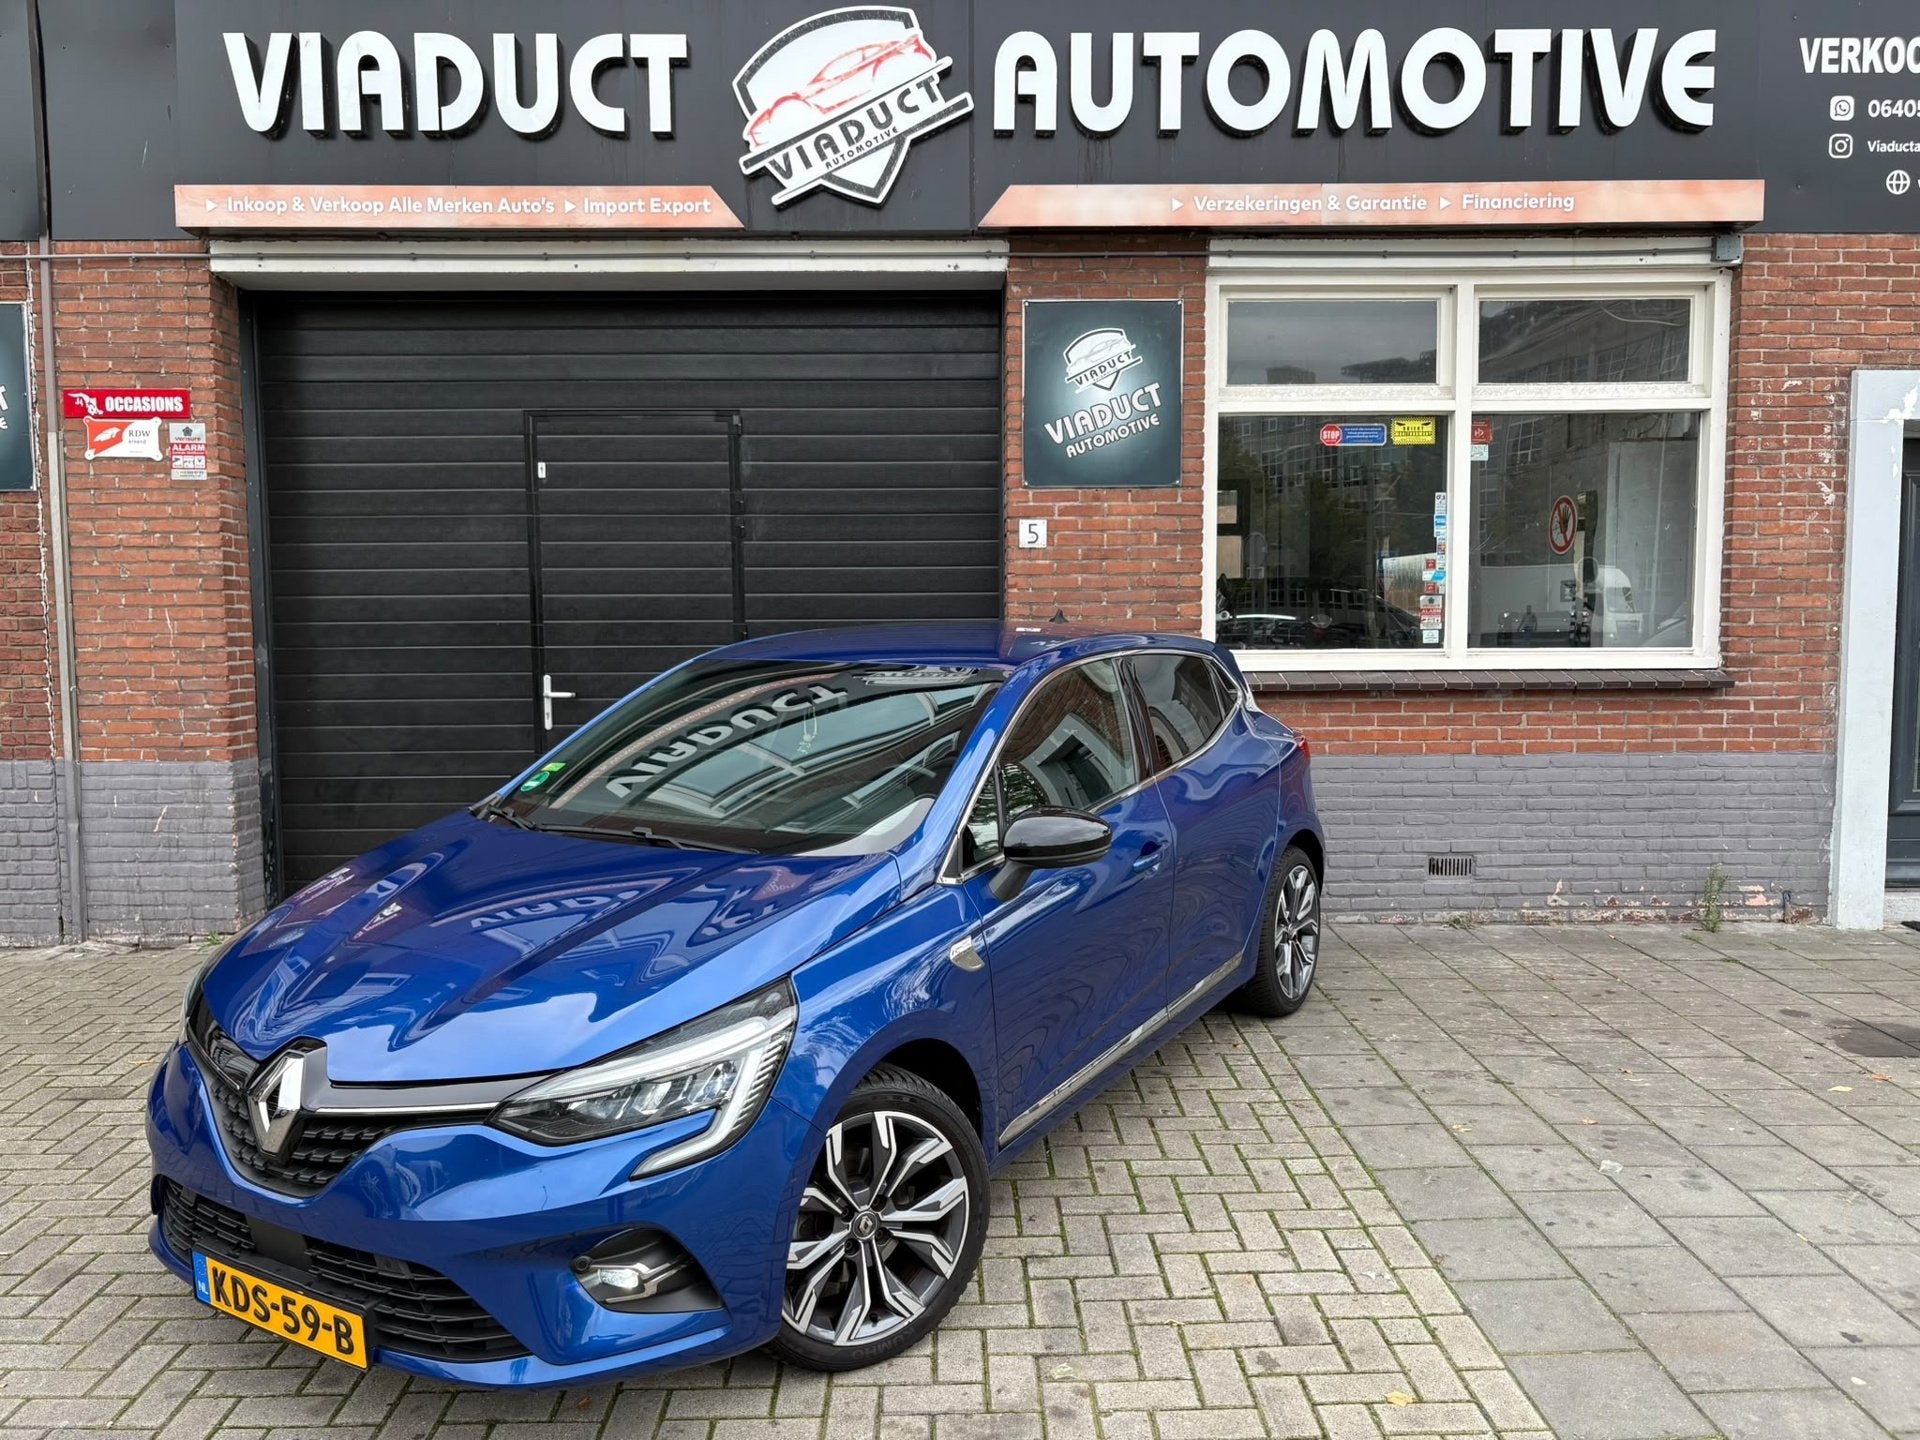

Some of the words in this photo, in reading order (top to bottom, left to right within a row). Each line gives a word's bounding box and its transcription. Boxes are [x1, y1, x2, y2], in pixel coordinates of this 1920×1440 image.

[223, 31, 689, 135] VIADUCT
[993, 27, 1718, 133] AUTOMOTIVE
[768, 75, 943, 181] VIADUCT
[825, 126, 899, 170] AUTOMOTIVE
[227, 196, 288, 216] Inkoop
[291, 197, 306, 213] &
[310, 196, 385, 217] Verkoop
[388, 197, 423, 213] Alle
[427, 197, 493, 214] Merken
[497, 197, 555, 214] Auto's
[583, 197, 646, 217] Import
[650, 197, 712, 216] Export
[1193, 194, 1322, 213] Verzekeringen
[1327, 195, 1341, 211] &
[1345, 193, 1427, 211] Garantie
[1462, 192, 1575, 212] Financiering
[1075, 350, 1132, 386] VIADUCT
[105, 396, 184, 413] OCCASIONS
[1043, 382, 1163, 445] VIADUCT
[128, 429, 151, 438] RDW
[1065, 413, 1160, 459] AUTOMOTIVE
[1322, 429, 1340, 440] STOP
[172, 443, 205, 452] ALARM
[1026, 522, 1039, 544] 5
[197, 1280, 209, 1295] NL
[211, 1266, 355, 1356] KDS-59-B
